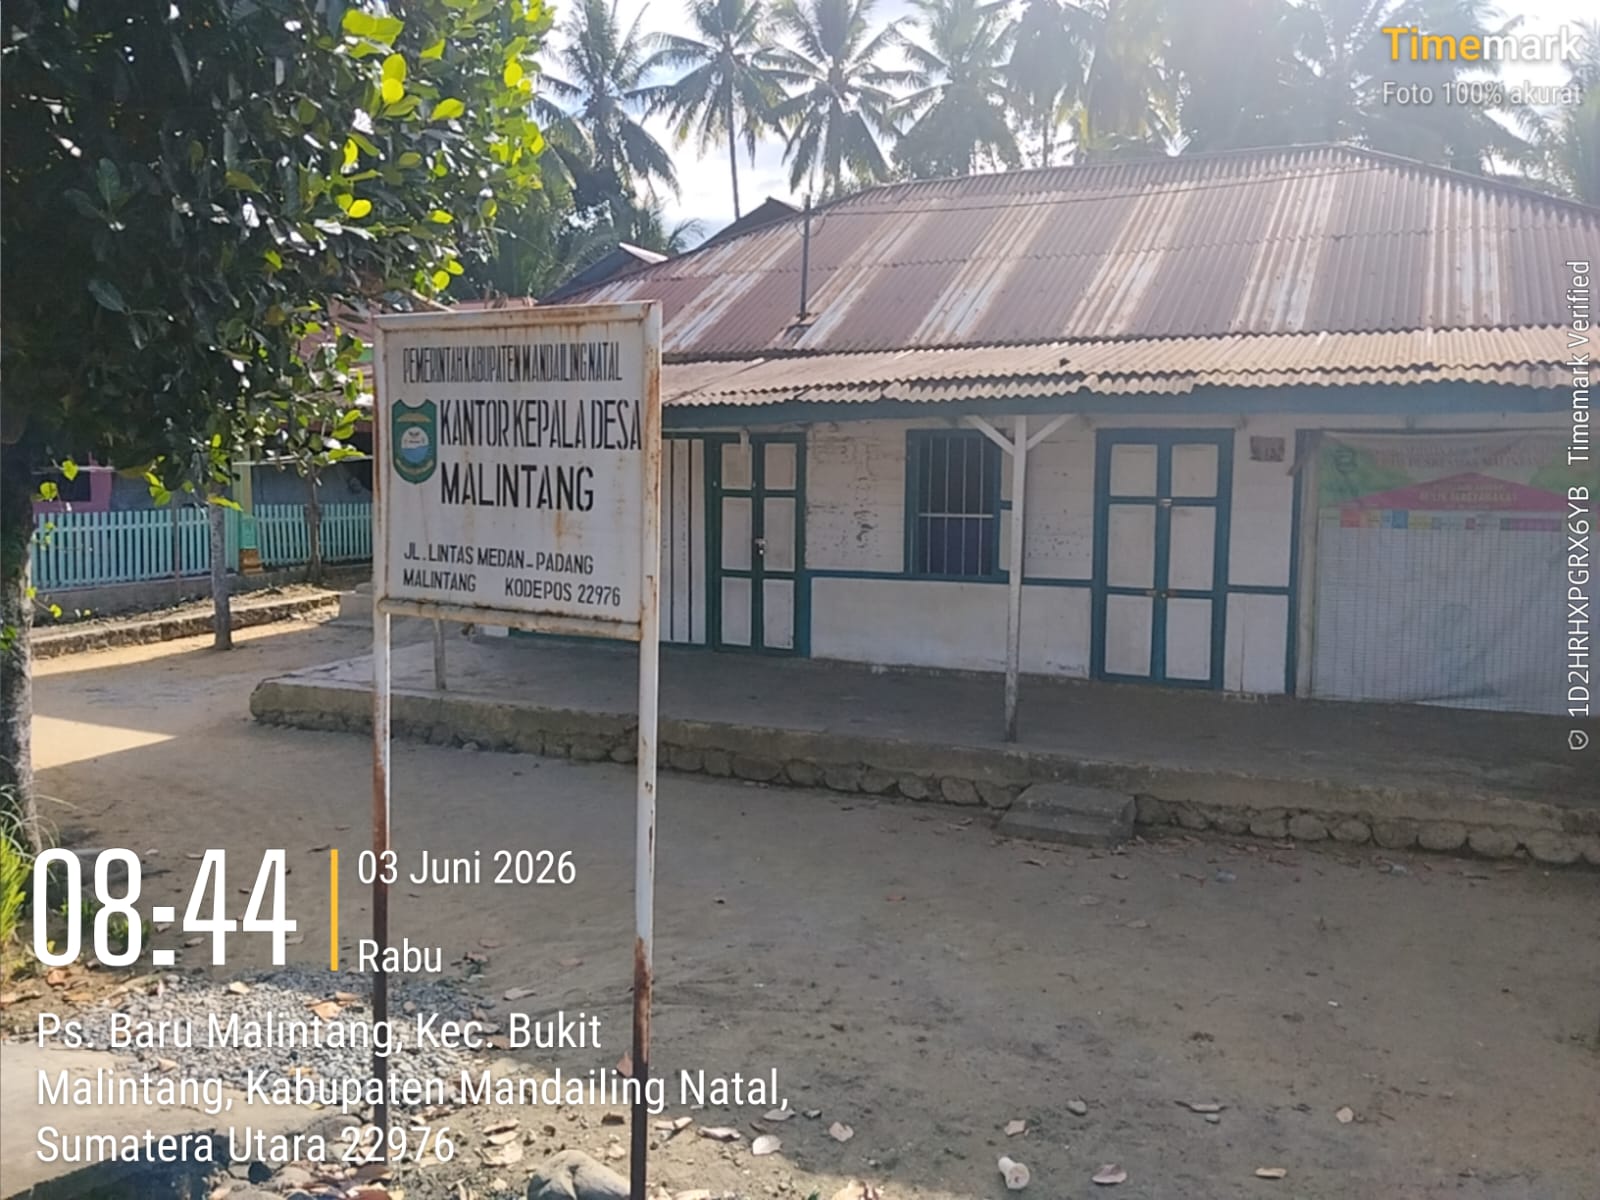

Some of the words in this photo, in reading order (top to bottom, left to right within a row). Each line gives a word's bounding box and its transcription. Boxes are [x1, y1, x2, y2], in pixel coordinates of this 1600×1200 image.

[588, 341, 622, 381] NATAL
[440, 399, 509, 447] KANTOR
[513, 399, 587, 449] KEPALA
[591, 399, 642, 450] DESA
[441, 462, 594, 512] MALINTANG
[428, 543, 474, 565] LINTAS
[403, 568, 476, 592] MALINTANG
[505, 577, 572, 602] KODEPOS
[577, 583, 621, 607] 22976
